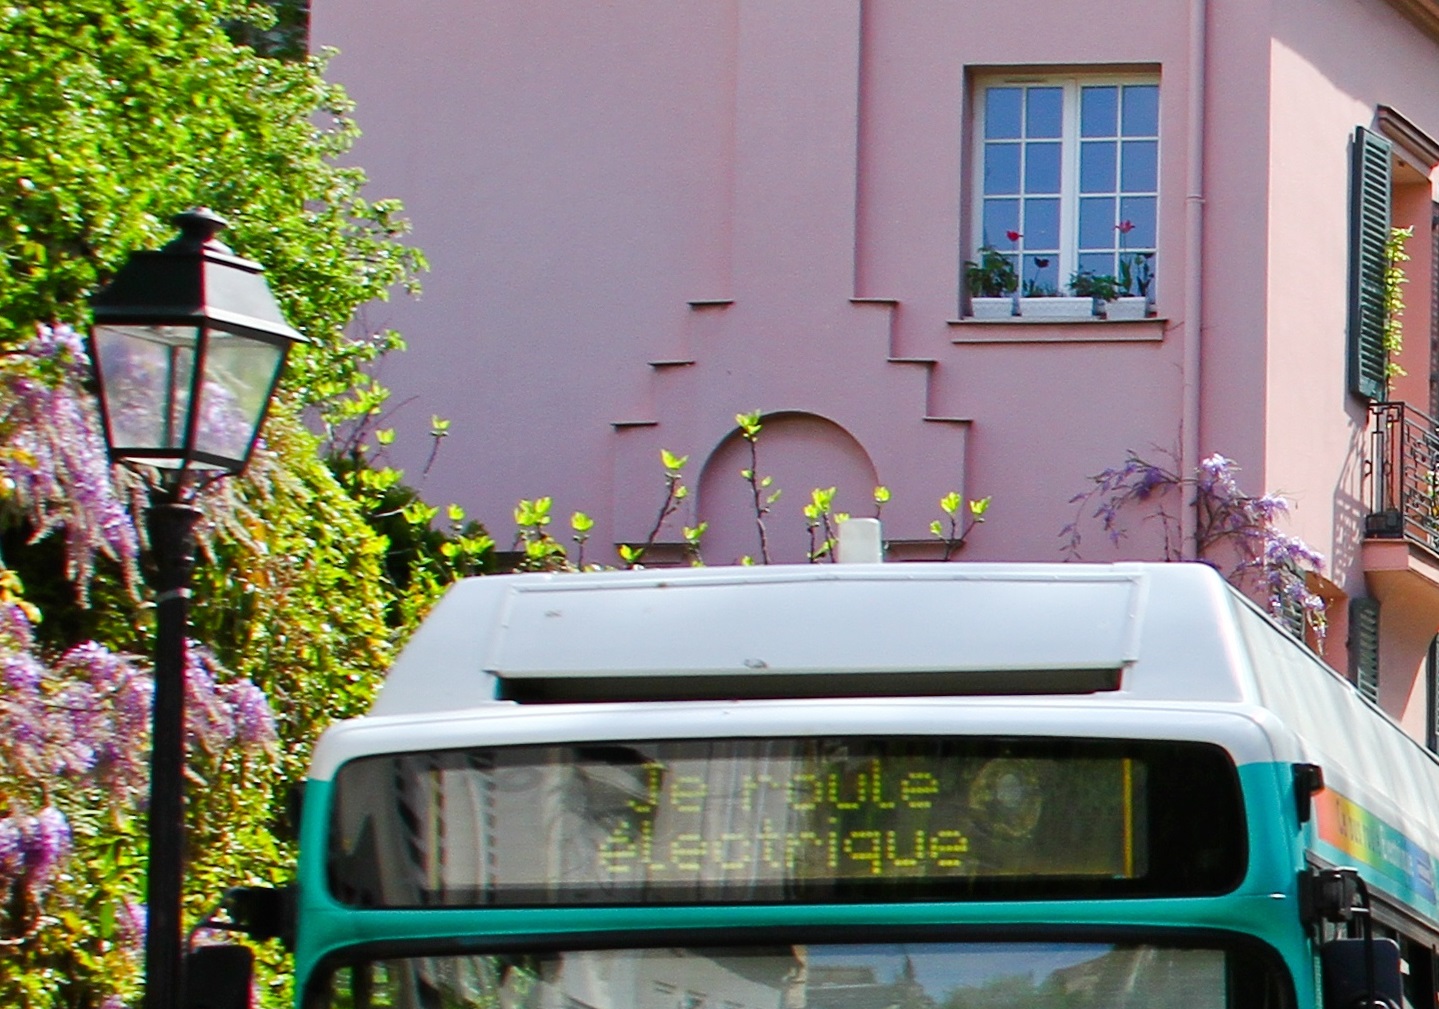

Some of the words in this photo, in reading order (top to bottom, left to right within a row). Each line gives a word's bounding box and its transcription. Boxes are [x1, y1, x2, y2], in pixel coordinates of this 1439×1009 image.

[626, 762, 708, 813] Je
[742, 758, 940, 812] roule
[599, 816, 969, 875] électrique
